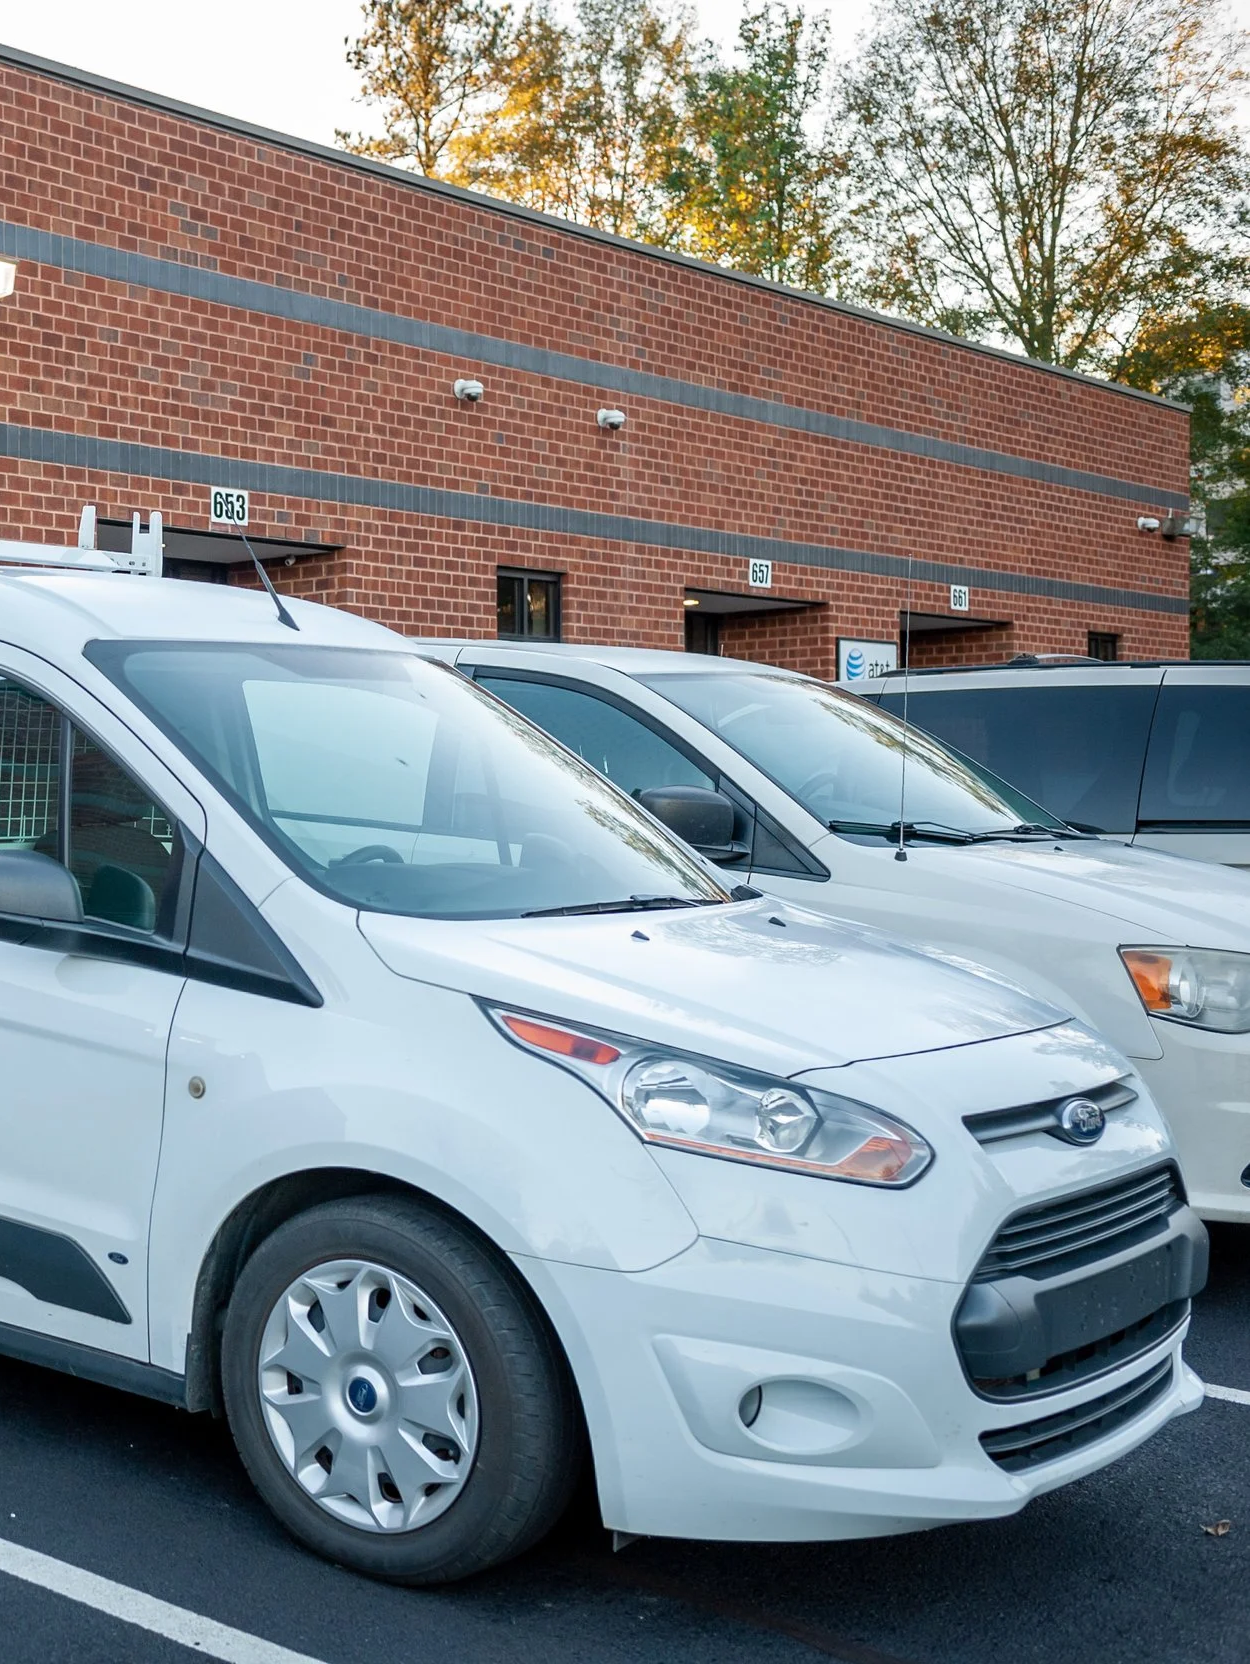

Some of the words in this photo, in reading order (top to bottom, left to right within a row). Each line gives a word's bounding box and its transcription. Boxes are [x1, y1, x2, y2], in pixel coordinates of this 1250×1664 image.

[213, 491, 246, 521] 653
[751, 562, 770, 585] 657
[952, 588, 967, 607] 661
